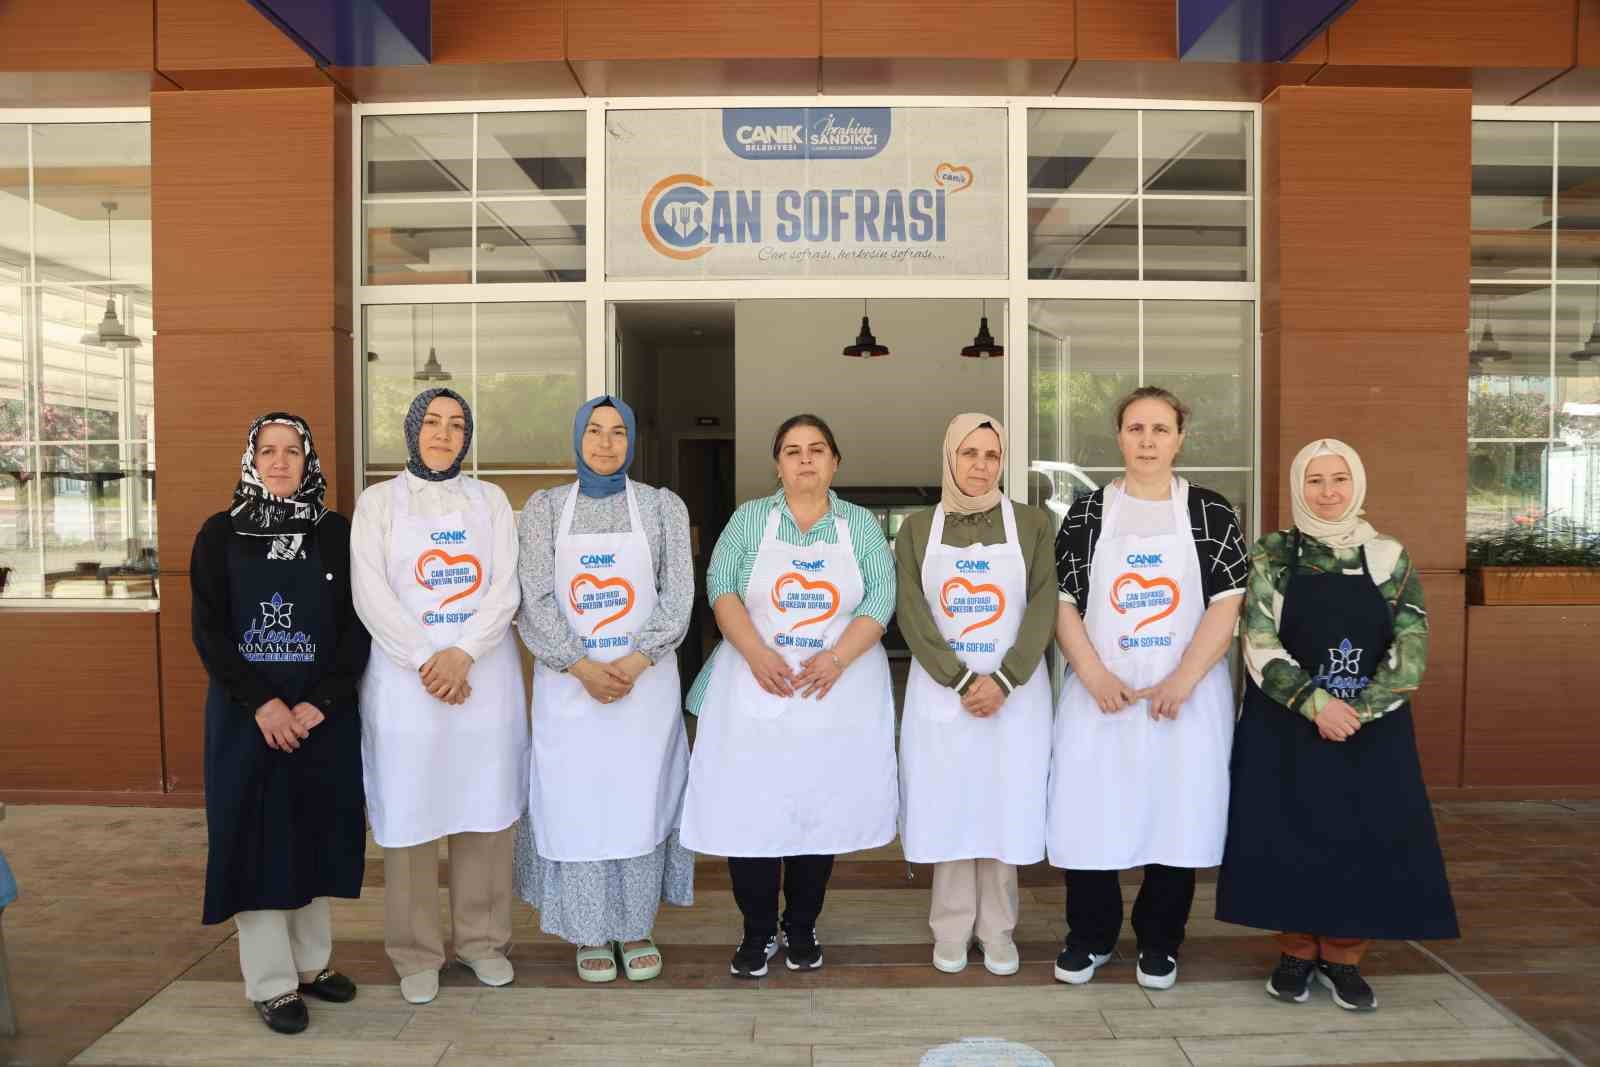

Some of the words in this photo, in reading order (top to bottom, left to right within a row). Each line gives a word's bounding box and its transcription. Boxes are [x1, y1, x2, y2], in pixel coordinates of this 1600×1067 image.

[809, 134, 878, 147] SANDIKÇI
[652, 186, 762, 248] CAN
[757, 246, 787, 262] Can
[431, 569, 444, 578] CAN
[582, 592, 595, 602] CAN
[787, 592, 800, 601] CAN
[953, 596, 965, 605] CAN
[1126, 592, 1139, 601] CAN
[238, 642, 316, 653] KONAKLARI
